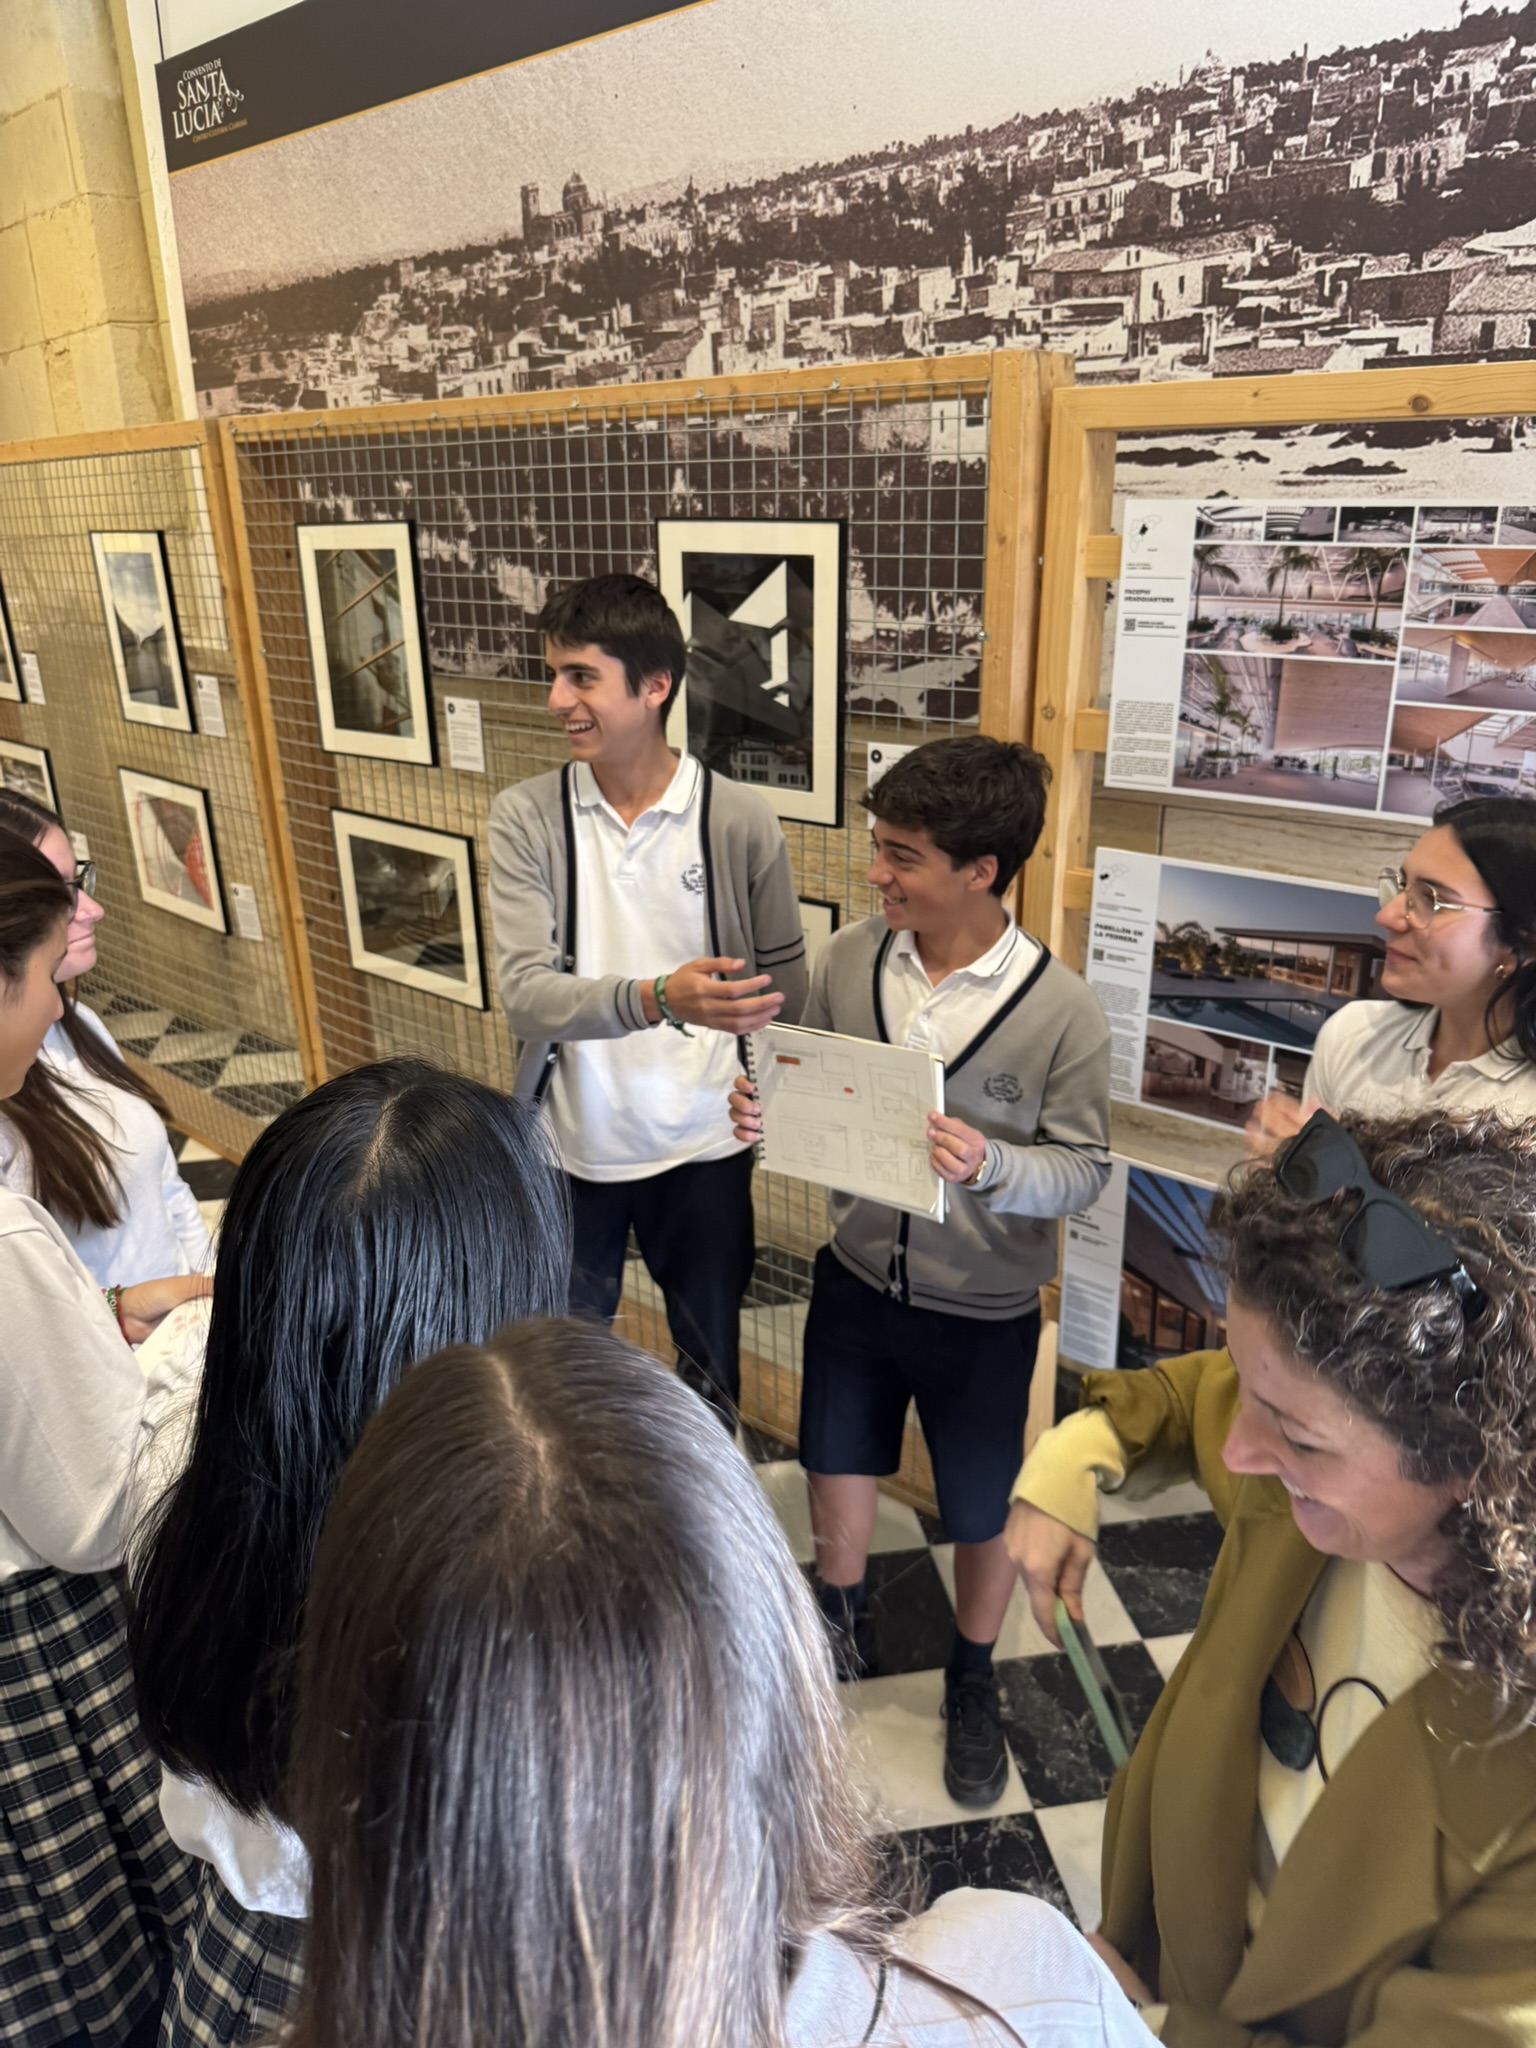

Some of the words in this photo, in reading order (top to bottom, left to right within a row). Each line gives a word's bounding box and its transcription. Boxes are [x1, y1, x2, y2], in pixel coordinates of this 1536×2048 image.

[183, 61, 213, 81] CONVENTO
[213, 57, 222, 69] DE
[177, 68, 230, 110] SANTA
[172, 92, 222, 139] LUCÍA
[1123, 596, 1175, 604] HEADQUARTERS
[1094, 923, 1132, 935] PABELLÓN
[1133, 929, 1143, 937] EN
[1094, 930, 1104, 938] LA
[1105, 932, 1139, 944] PEDRERA
